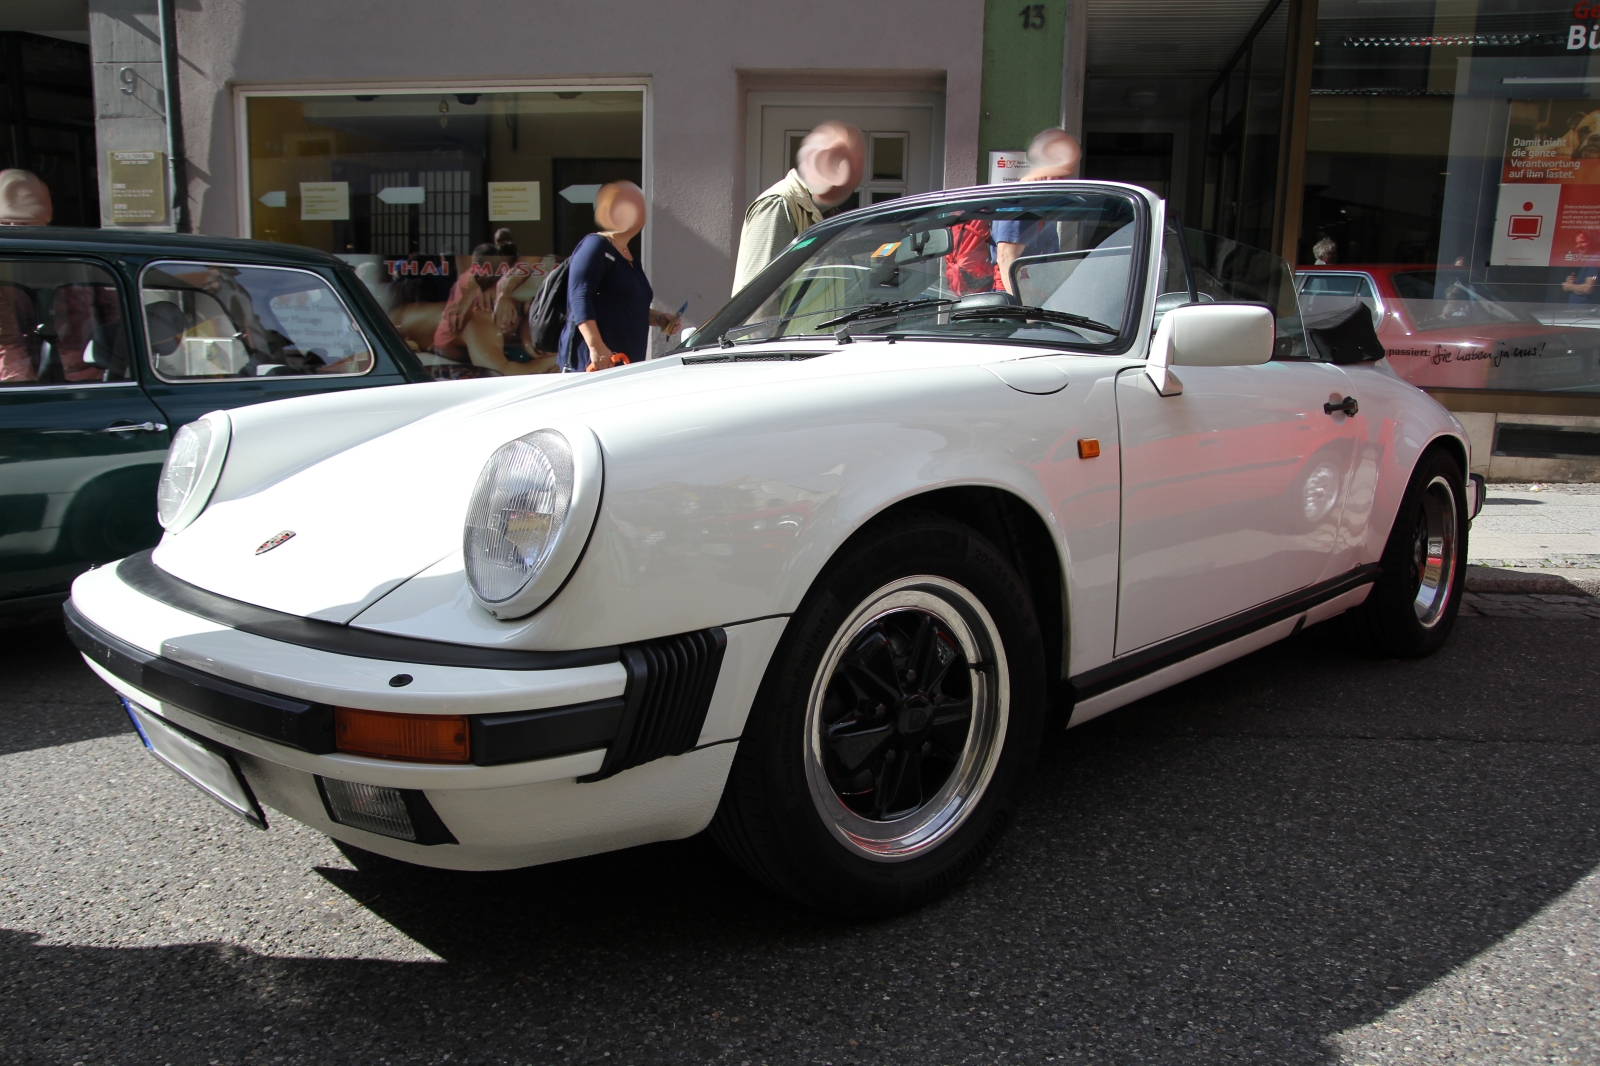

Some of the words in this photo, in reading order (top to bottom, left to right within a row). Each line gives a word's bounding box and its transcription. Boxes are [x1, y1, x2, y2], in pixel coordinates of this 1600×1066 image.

[1018, 4, 1045, 30] 13
[118, 66, 138, 96] 9
[1513, 138, 1543, 147] Damit
[1543, 138, 1567, 147] nicht
[1511, 148, 1526, 157] die
[1528, 150, 1556, 159] ganze
[1511, 159, 1581, 170] Verantwortung
[1509, 169, 1525, 178] auf
[1526, 169, 1544, 178] ihm
[1546, 169, 1575, 179] lastet.
[383, 260, 449, 276] THAI
[1388, 347, 1431, 357] passiert:
[973, 548, 1008, 583] 205/55
[1008, 581, 1016, 595] R
[781, 616, 828, 797] ContiPremiumContact
